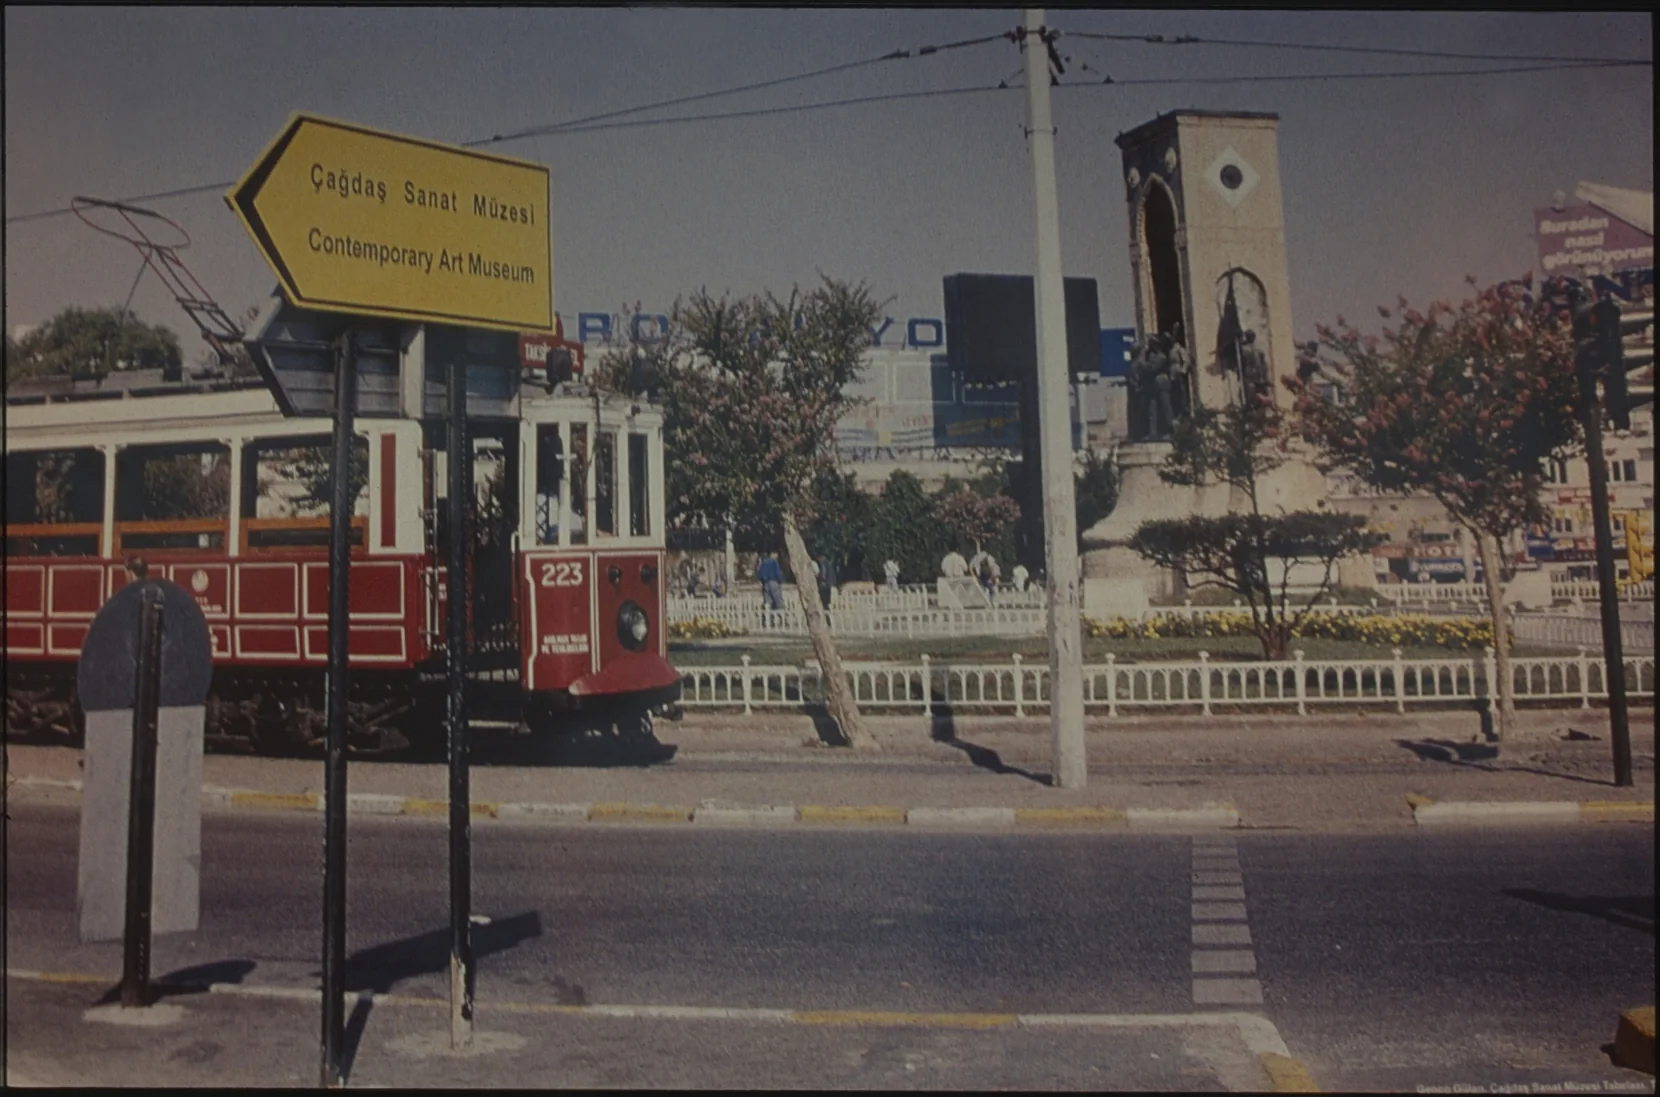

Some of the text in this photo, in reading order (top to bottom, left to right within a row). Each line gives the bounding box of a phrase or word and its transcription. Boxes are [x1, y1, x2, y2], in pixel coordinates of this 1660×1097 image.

[310, 163, 535, 226] Çağdaş Sanat Müzesi
[308, 227, 535, 285] Contemporary Art Museum
[541, 561, 584, 587] 223
